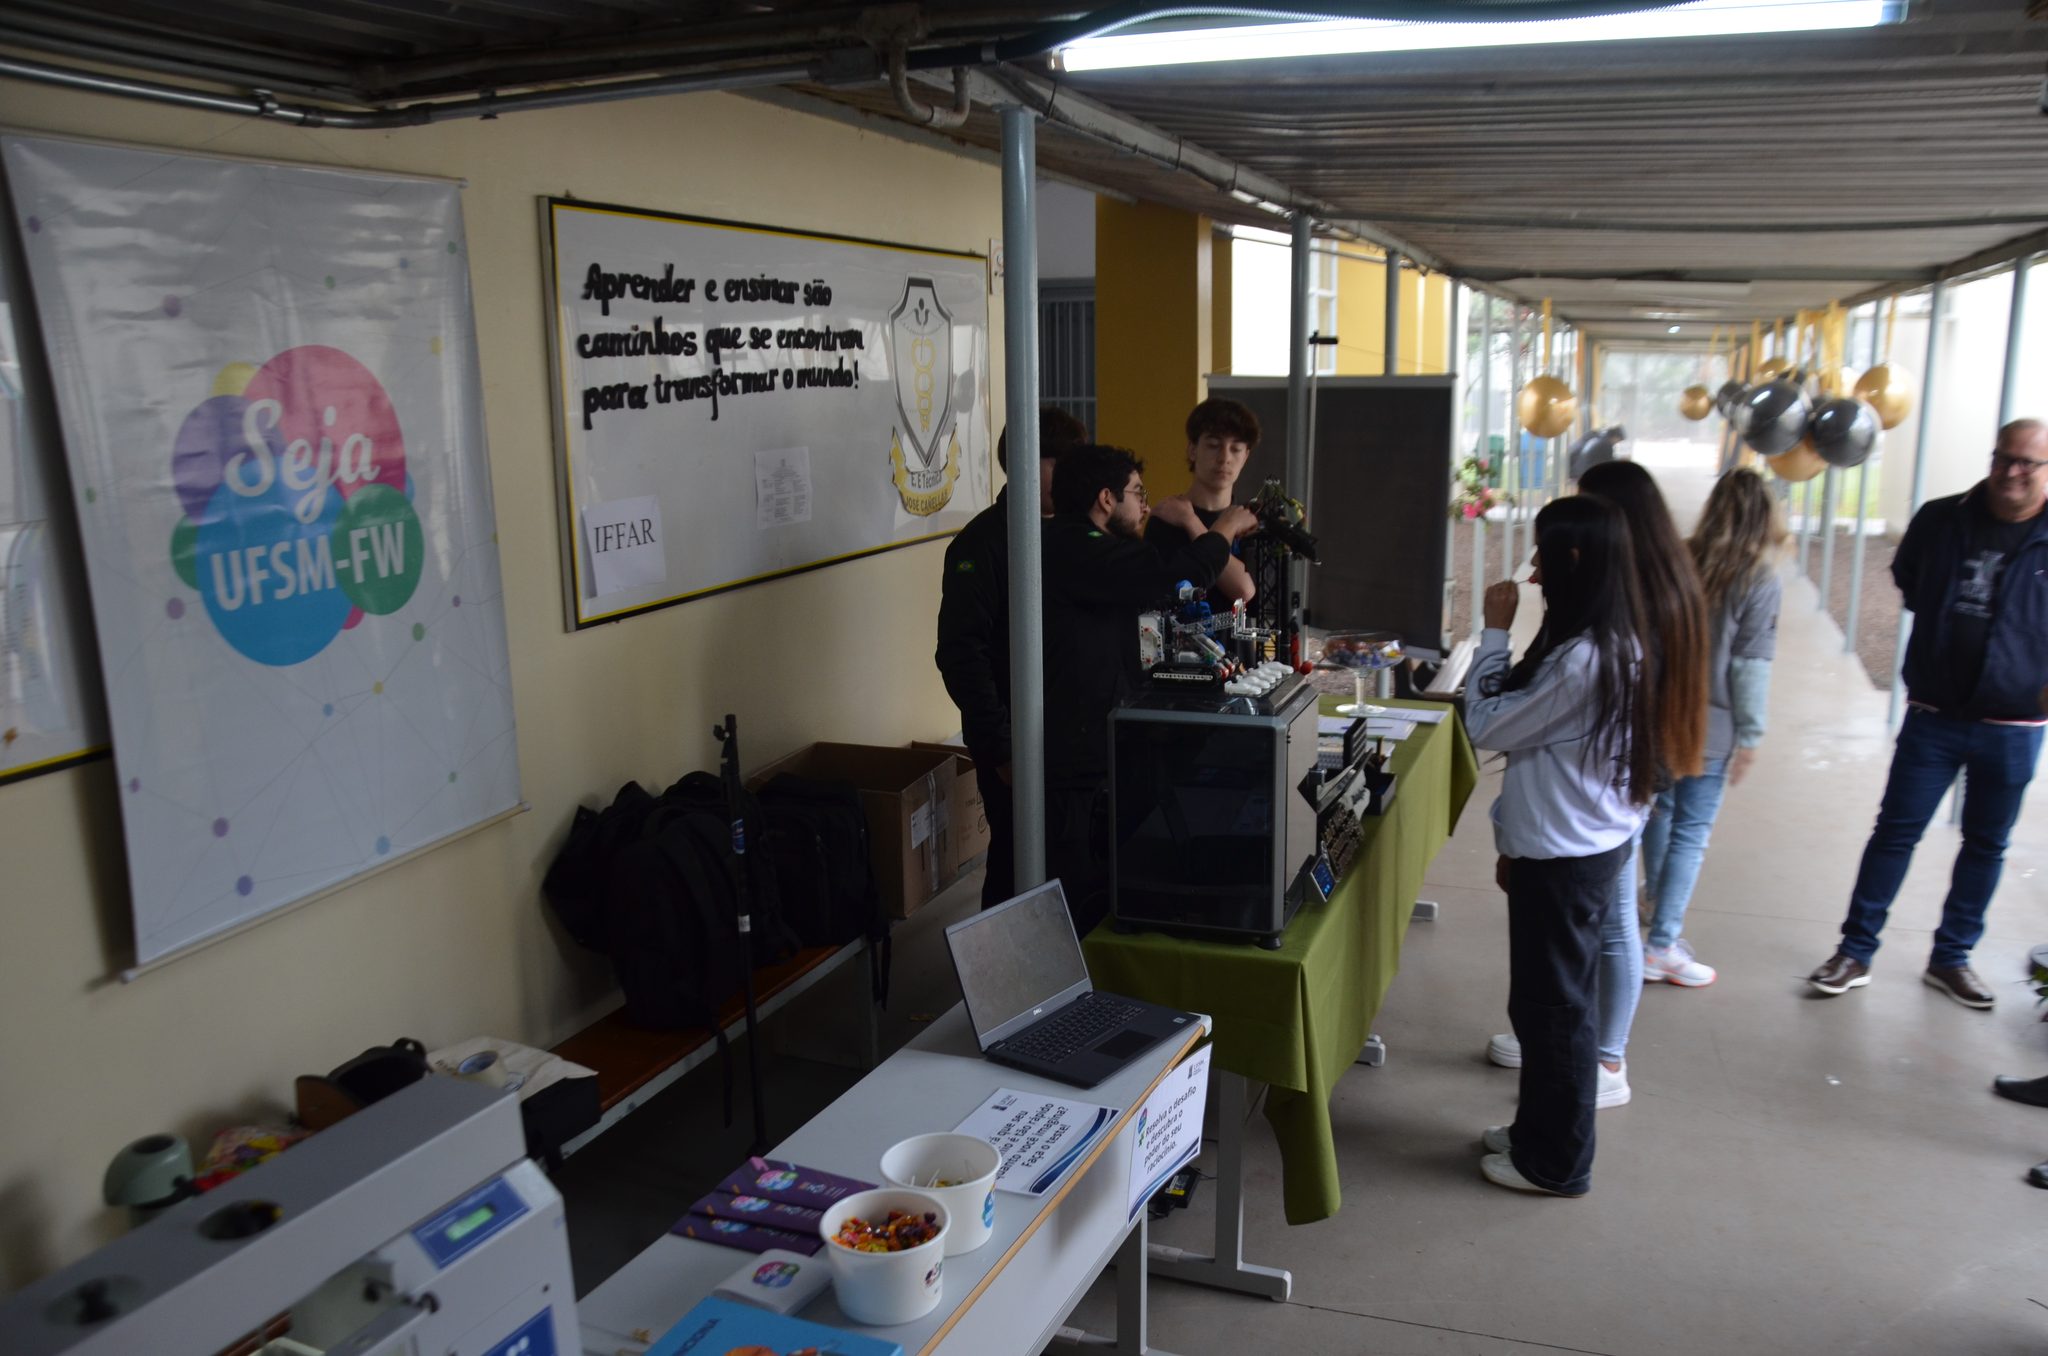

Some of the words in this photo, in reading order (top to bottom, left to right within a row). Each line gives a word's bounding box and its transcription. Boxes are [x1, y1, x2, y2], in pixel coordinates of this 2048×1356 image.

[582, 263, 695, 316] Aprender
[705, 279, 719, 302] e
[724, 273, 799, 304] ensinar
[803, 279, 832, 306] são
[577, 316, 698, 358] caminhos
[705, 327, 747, 365] que
[750, 326, 772, 350] se
[776, 325, 864, 351] encontram
[582, 382, 648, 430] para
[653, 368, 779, 421] transformar
[783, 368, 794, 389] o
[797, 355, 859, 389] mundo!
[225, 398, 381, 524] Seja
[594, 518, 656, 553] IFFAR
[210, 521, 405, 612] UFSM-FW
[997, 1122, 1016, 1137] que
[1011, 1110, 1028, 1122] seu
[1017, 1136, 1040, 1153] você
[1031, 1105, 1069, 1136] imagina?
[1027, 1103, 1054, 1125] rápido
[1146, 1109, 1167, 1137] Resolva
[1168, 1104, 1173, 1115] o
[1173, 1086, 1197, 1110] desafio
[1146, 1140, 1151, 1150] e
[1150, 1113, 1178, 1144] descubra
[1178, 1109, 1183, 1118] o
[1020, 1150, 1045, 1168] Faça
[1045, 1123, 1071, 1144] teste!
[1144, 1141, 1161, 1167] poder
[1162, 1133, 1170, 1146] do
[1170, 1122, 1183, 1138] seu
